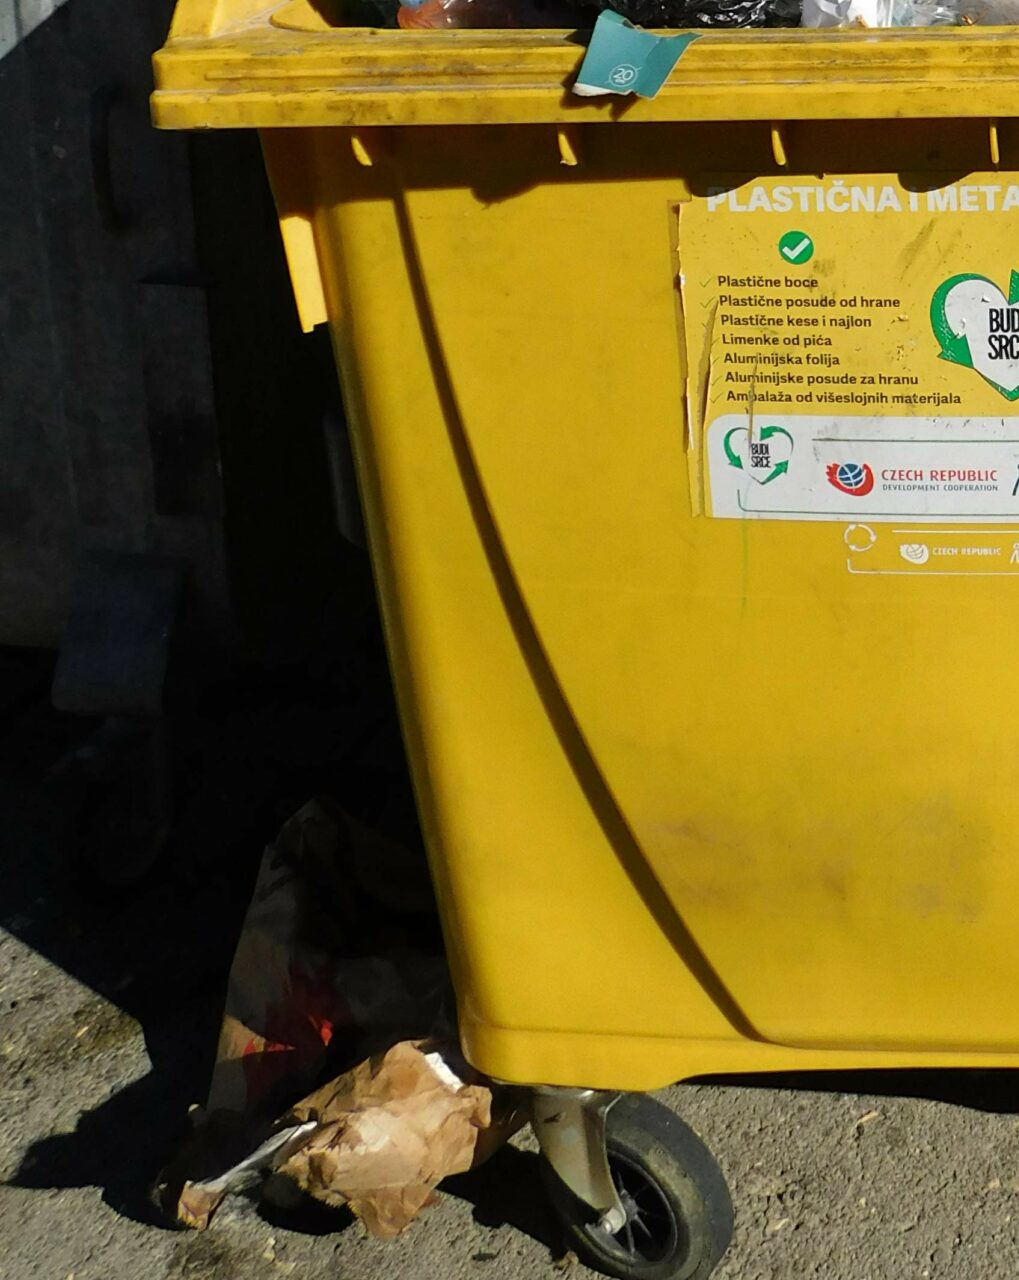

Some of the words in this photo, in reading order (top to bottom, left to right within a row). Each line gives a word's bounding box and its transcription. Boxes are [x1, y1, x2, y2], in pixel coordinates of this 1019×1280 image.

[612, 68, 634, 81] 20
[706, 180, 902, 213] PLASTIČNA
[909, 186, 920, 213] I
[717, 275, 781, 288] Plastične
[784, 275, 818, 288] boce
[719, 295, 783, 308] Plastične
[786, 295, 836, 311] posude
[839, 295, 857, 308] od
[860, 296, 900, 308] hrane
[720, 314, 784, 328] Plastične
[787, 314, 819, 328] kese
[822, 315, 827, 327] i
[829, 315, 872, 330] najlon
[722, 333, 780, 346] Limenke
[783, 333, 800, 346] od
[803, 334, 832, 349] pića
[723, 352, 802, 367] Aluminijska
[805, 352, 840, 368] folija
[725, 371, 804, 386] Aluminijske
[807, 372, 857, 387] posude
[860, 375, 875, 385] za
[878, 373, 919, 386] hranu
[726, 390, 792, 403] Ambalaža
[796, 391, 813, 404] od
[816, 391, 888, 407] višeslojnih
[892, 392, 961, 407] materijala
[751, 443, 769, 455] BUDI
[751, 456, 771, 468] SRCE
[881, 469, 924, 481] CZECH
[930, 469, 998, 481] REPUBLIC
[883, 484, 940, 492] DEVELOPMENT
[943, 484, 998, 492] COOPERATION
